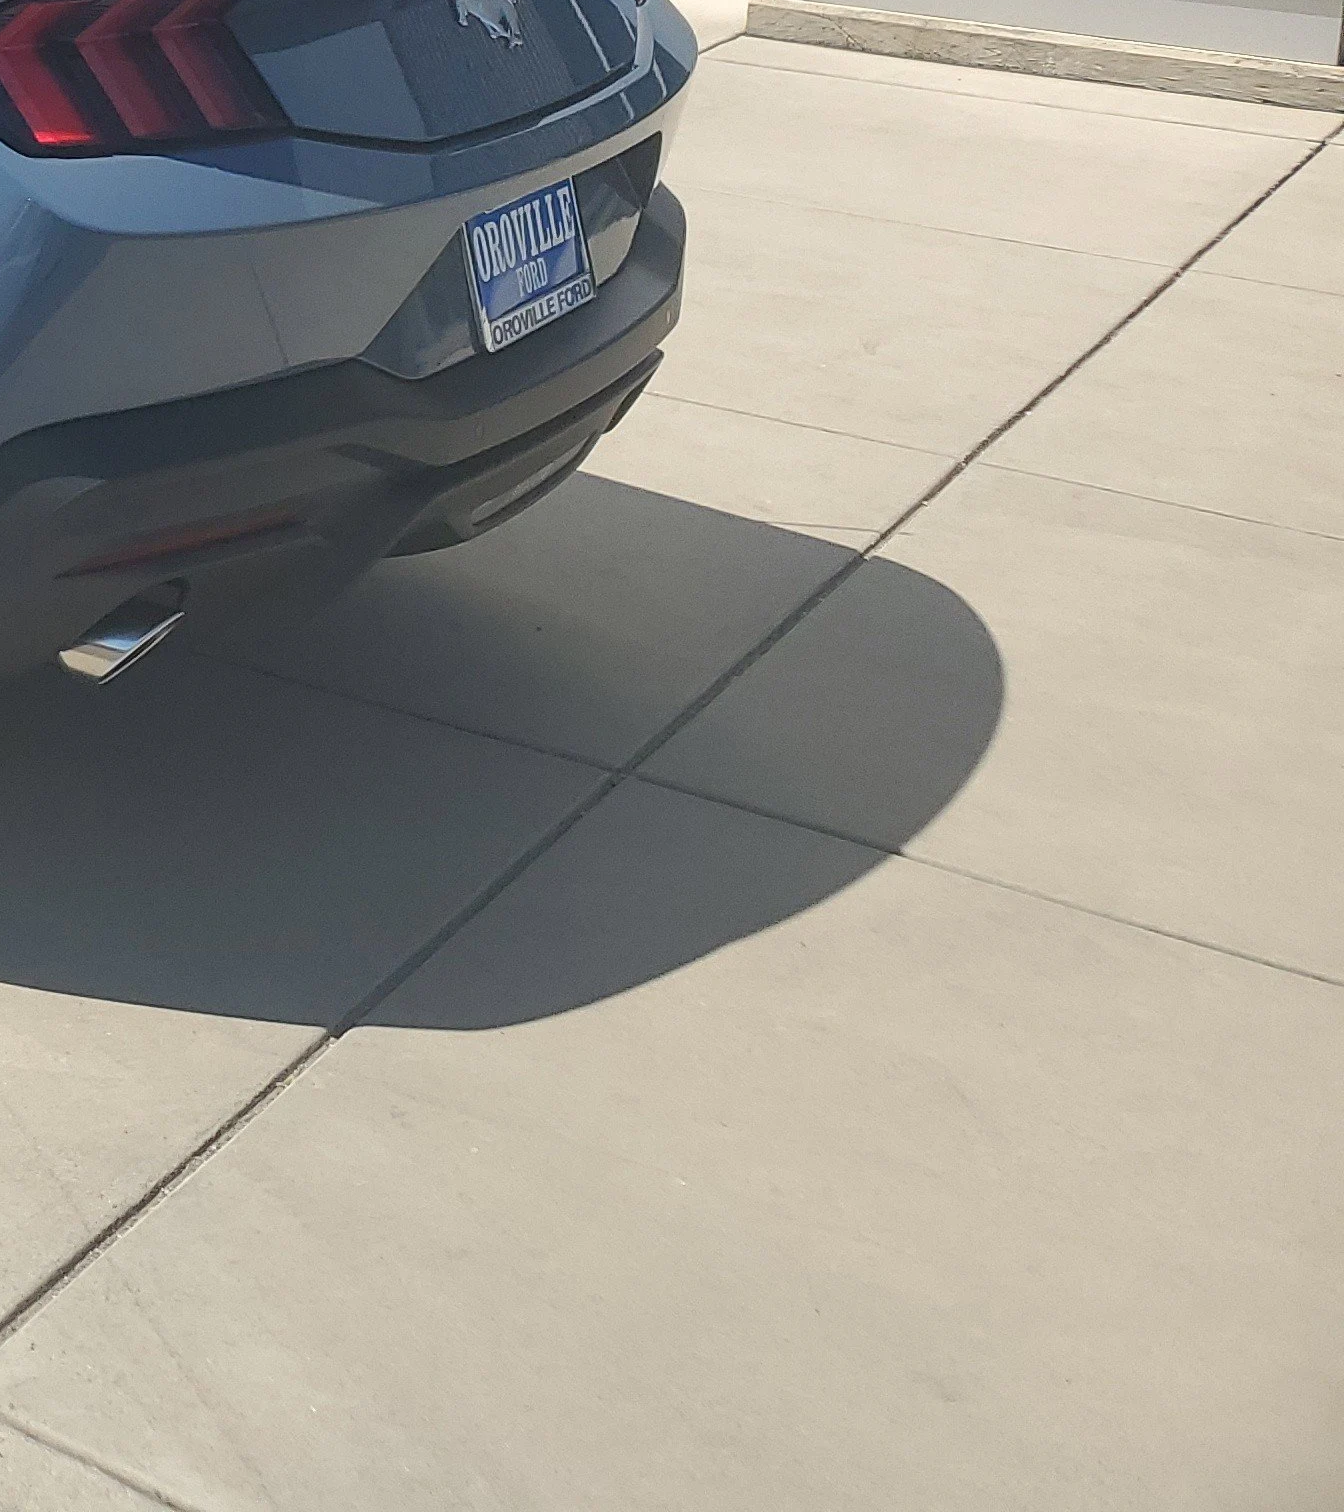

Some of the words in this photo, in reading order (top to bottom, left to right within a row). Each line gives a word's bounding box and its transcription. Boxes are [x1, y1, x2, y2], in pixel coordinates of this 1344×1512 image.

[472, 185, 577, 283] OROVILLE
[516, 257, 548, 298] FORD
[493, 297, 557, 346] OROVILLE
[557, 279, 592, 313] FORD
